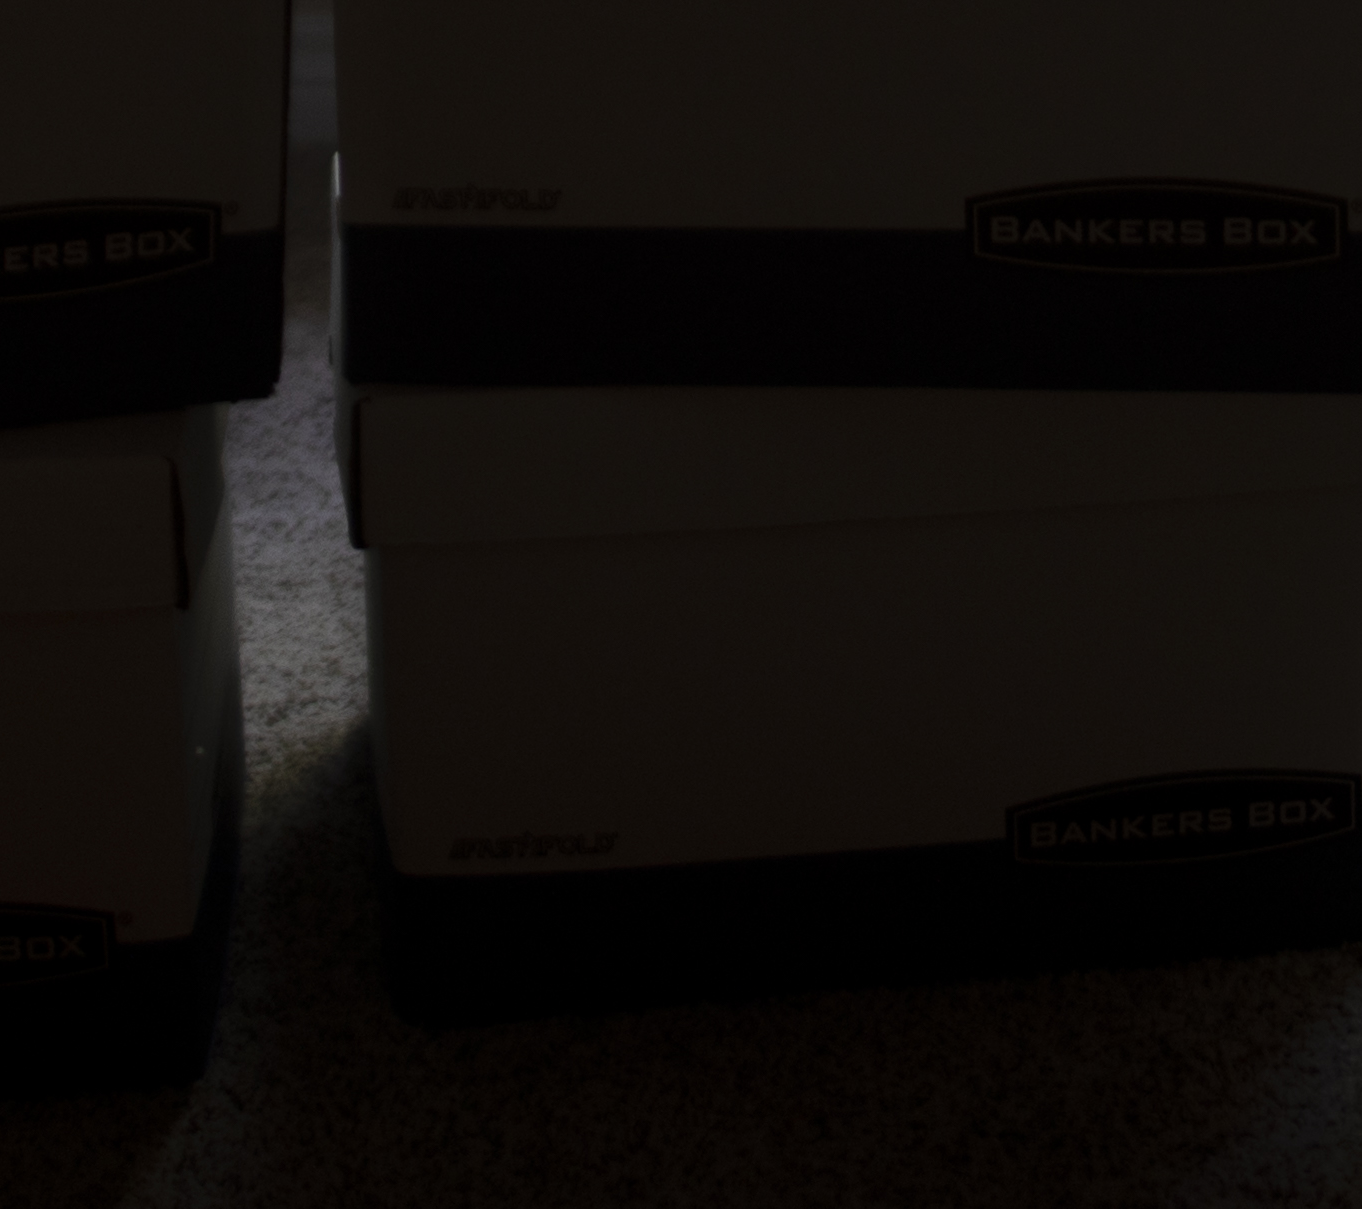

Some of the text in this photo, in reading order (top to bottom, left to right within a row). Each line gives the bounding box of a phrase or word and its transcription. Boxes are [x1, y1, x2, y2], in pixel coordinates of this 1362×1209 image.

[104, 226, 195, 264] BOX
[989, 216, 1318, 247] BANKERS BOX
[1029, 796, 1336, 849] BANKERS BOX
